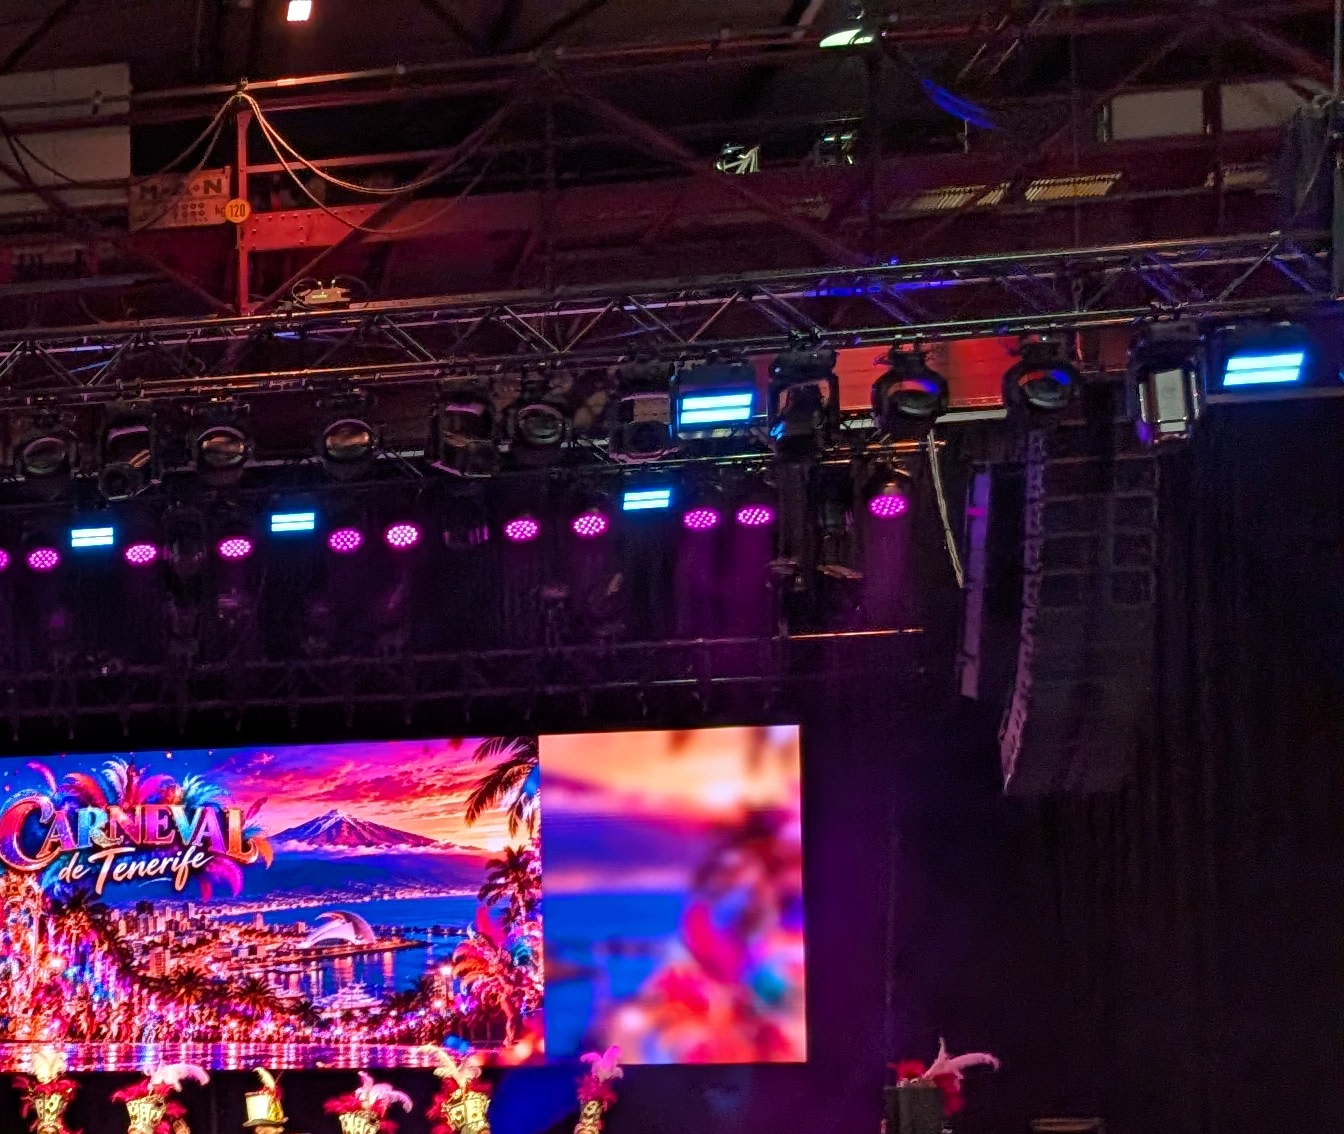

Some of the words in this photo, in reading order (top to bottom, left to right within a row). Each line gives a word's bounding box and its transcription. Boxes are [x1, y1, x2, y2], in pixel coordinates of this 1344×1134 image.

[229, 204, 246, 218] 120
[59, 852, 89, 883] de
[87, 846, 215, 895] Tenerife
